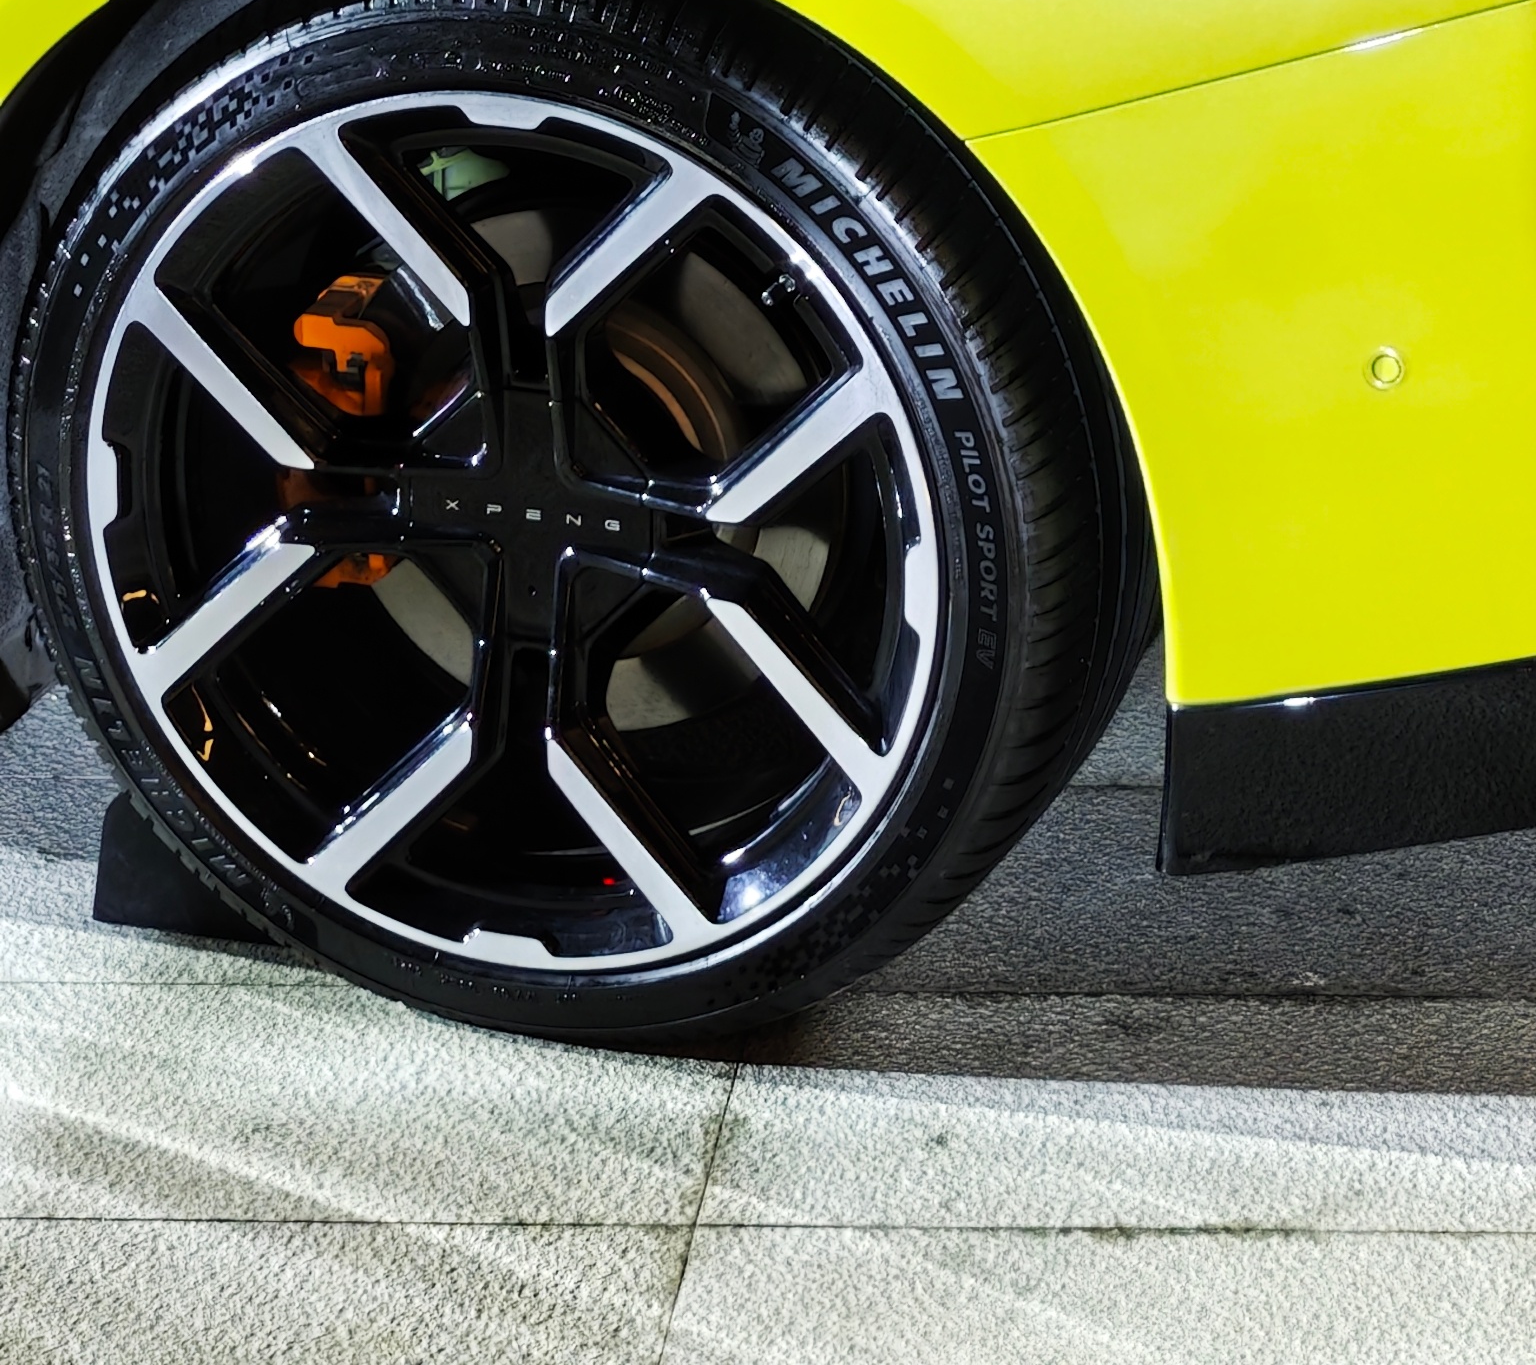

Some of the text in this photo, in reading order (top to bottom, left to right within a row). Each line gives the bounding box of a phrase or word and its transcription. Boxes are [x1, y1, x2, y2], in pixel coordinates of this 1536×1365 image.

[770, 156, 965, 401] MICHELIN
[445, 499, 621, 532] XPENG
[953, 429, 991, 516] PILOT
[975, 522, 998, 623] SPORT
[976, 628, 997, 671] EV
